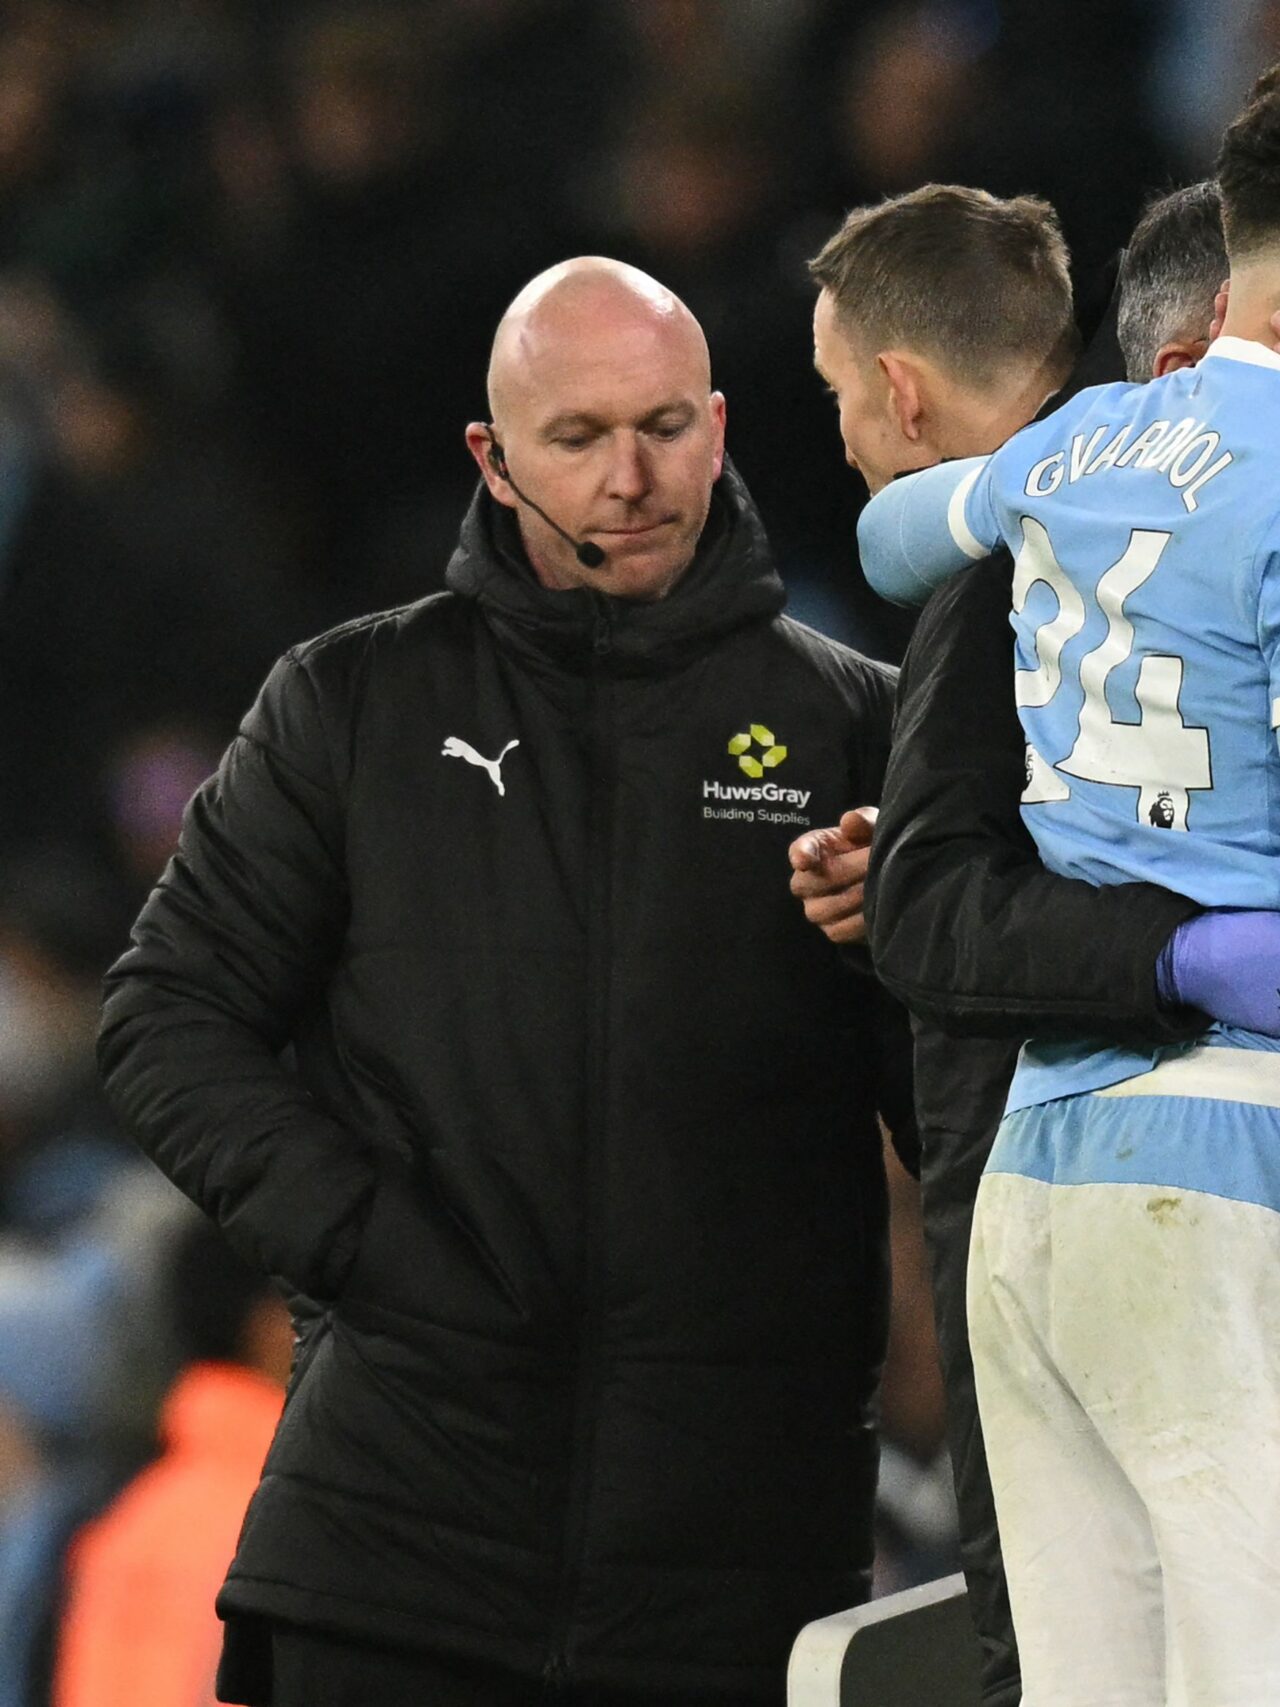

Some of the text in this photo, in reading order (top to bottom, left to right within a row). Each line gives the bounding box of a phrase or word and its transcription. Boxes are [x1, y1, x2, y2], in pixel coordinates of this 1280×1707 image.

[1024, 417, 1234, 513] GVARDIOL
[1012, 515, 1214, 833] 24
[703, 780, 811, 809] HuwsGray
[703, 807, 810, 825] Building Supplies
